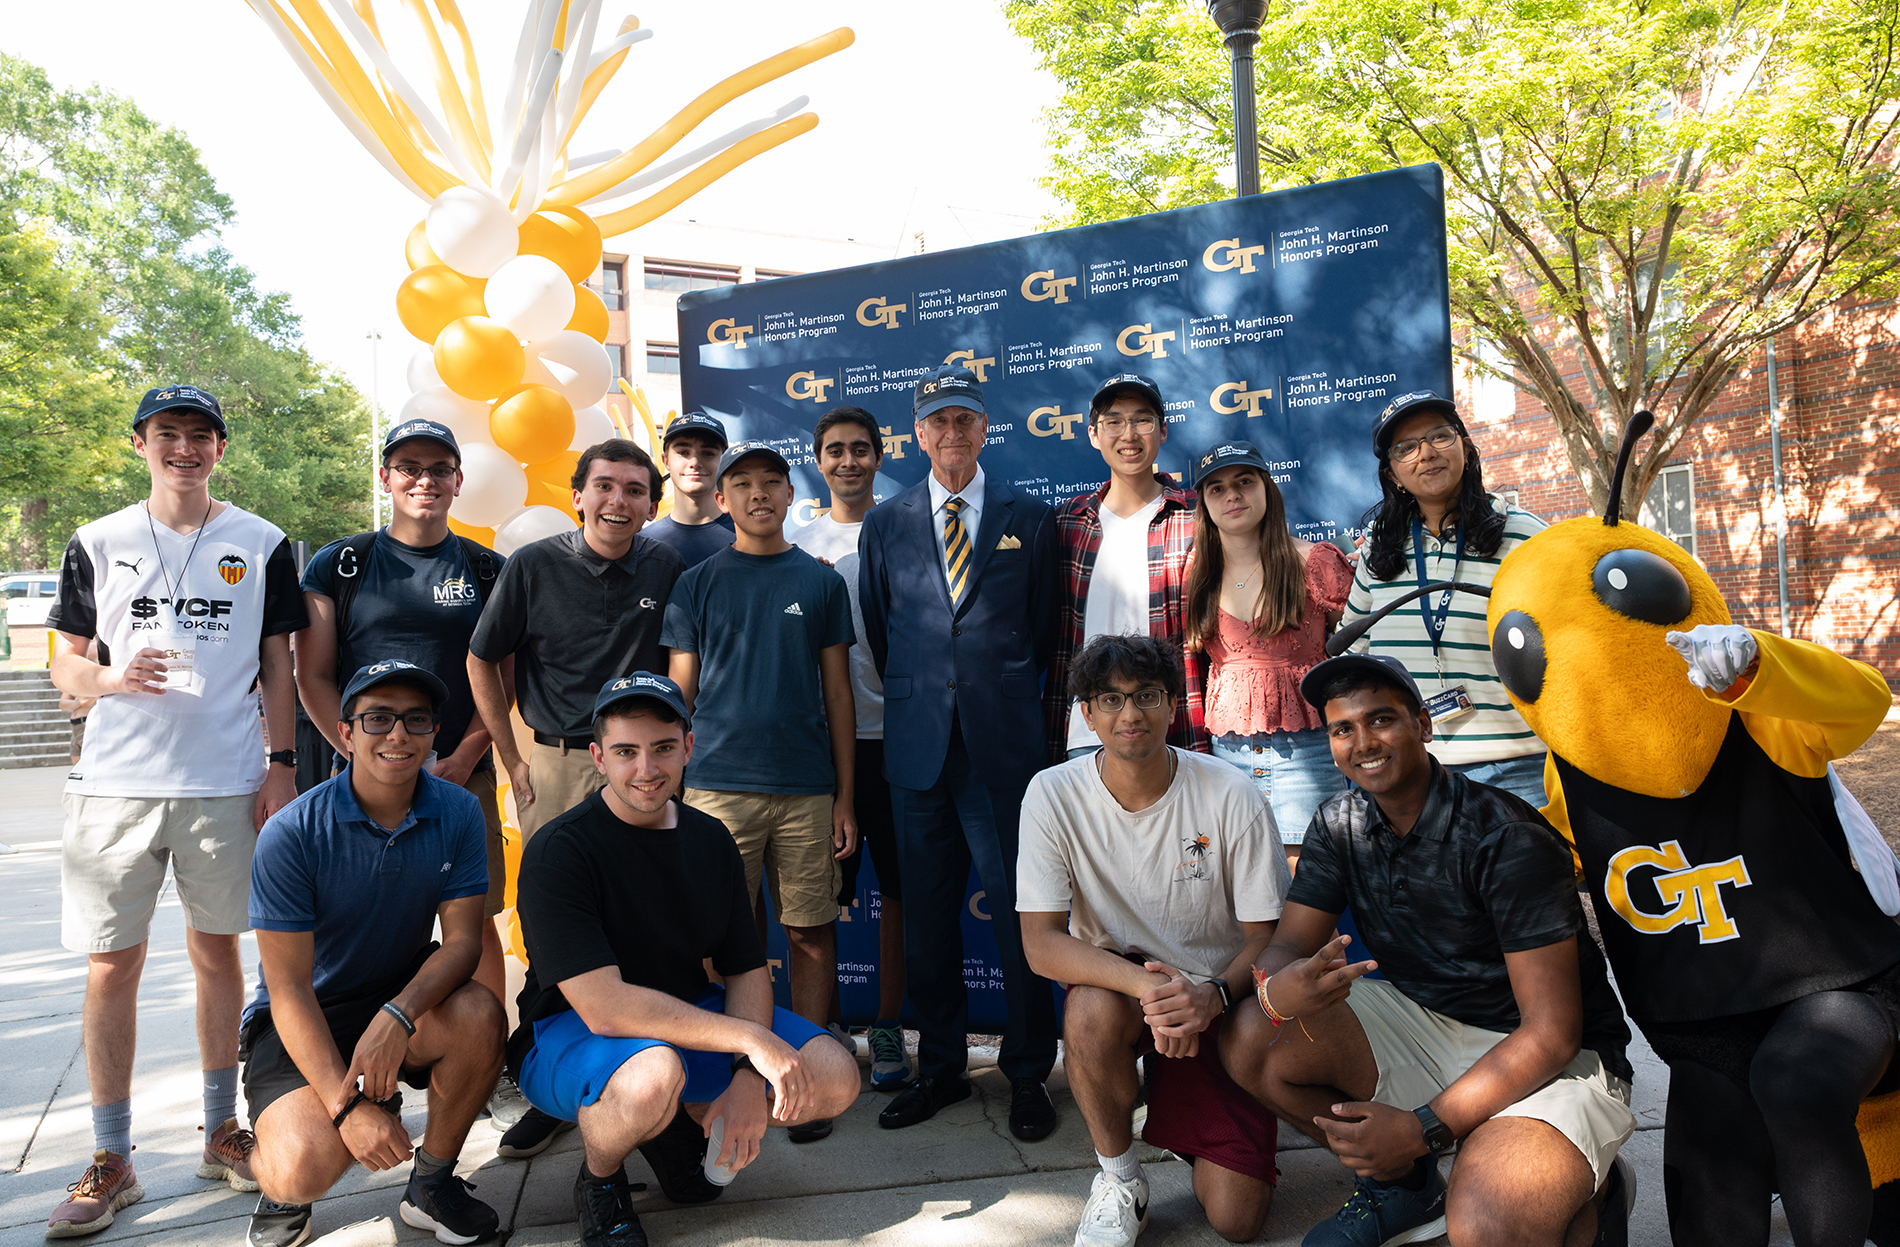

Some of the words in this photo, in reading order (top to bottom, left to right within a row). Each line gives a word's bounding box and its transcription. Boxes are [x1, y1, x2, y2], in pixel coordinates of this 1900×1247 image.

[1279, 229, 1304, 239] Georgia
[1304, 225, 1320, 234] Tech
[1279, 239, 1307, 250] John
[1312, 234, 1324, 245] H.
[1328, 225, 1388, 242] Martinson
[1203, 238, 1264, 274] GT
[1281, 249, 1322, 263] Honors
[1327, 240, 1378, 255] Program
[1090, 262, 1112, 271] Georgia
[1112, 259, 1127, 267] Tech
[1090, 271, 1115, 282] John
[1118, 267, 1131, 278] H.
[1134, 260, 1187, 275] Martinson
[1021, 269, 1077, 304] GT
[1091, 282, 1128, 294] Honors
[1132, 273, 1178, 287] Program
[918, 290, 939, 298] Georgia
[938, 287, 952, 295] Tech
[918, 298, 942, 310] John
[944, 295, 955, 306] H.
[958, 289, 1007, 303] Martinson
[763, 313, 783, 321] Georgia
[856, 296, 906, 329] GT
[920, 309, 953, 320] Honors
[957, 303, 998, 315] Program
[1189, 316, 1213, 325] Georgia
[1212, 312, 1228, 321] Tech
[763, 320, 786, 332] John
[787, 318, 798, 328] H.
[800, 314, 844, 326] Martinson
[1189, 325, 1216, 337] John
[1220, 321, 1233, 333] H.
[1236, 314, 1293, 330] Martinson
[707, 318, 753, 349] GT
[764, 331, 797, 343] Honors
[799, 326, 837, 337] Program
[1191, 337, 1230, 349] Honors
[1234, 329, 1283, 342] Program
[1007, 343, 1029, 352] Georgia
[1116, 323, 1175, 359] GT
[1007, 351, 1033, 363] John
[1035, 348, 1047, 360] H.
[1050, 343, 1102, 356] Martinson
[845, 366, 865, 374] Georgia
[1009, 363, 1045, 374] Honors
[1049, 356, 1092, 369] Program
[845, 373, 868, 385] John
[870, 371, 881, 382] H.
[883, 367, 930, 379] Martinson
[1287, 374, 1312, 383] Georgia
[1311, 371, 1328, 379] Tech
[786, 371, 834, 403] GT
[846, 384, 880, 396] Honors
[923, 382, 937, 394] GT
[1287, 384, 1315, 395] John
[1320, 380, 1331, 391] H.
[1336, 374, 1396, 388] Martinson
[154, 389, 176, 401] GT
[1209, 381, 1272, 417] GT
[1289, 396, 1330, 408] Honors
[1334, 388, 1385, 402] Program
[1165, 399, 1196, 411] inson
[675, 416, 691, 426] GT
[986, 422, 1013, 434] inson
[1027, 405, 1083, 440] GT
[395, 427, 411, 438] GT
[731, 444, 747, 455] GT
[792, 444, 803, 455] H.
[1201, 454, 1213, 468] GT
[1266, 460, 1300, 471] inson
[1014, 479, 1036, 487] Georgia
[1041, 485, 1053, 496] H.
[1295, 522, 1320, 530] Georgia
[1320, 519, 1336, 527] Tech
[433, 584, 475, 600] MRG
[131, 596, 233, 620] $VCF
[640, 598, 657, 609] GT
[368, 664, 391, 675] GT
[611, 679, 631, 691] GT
[1604, 839, 1752, 944] GT
[836, 961, 875, 972] artinson
[976, 966, 988, 977] H.
[837, 974, 868, 985] ogram
